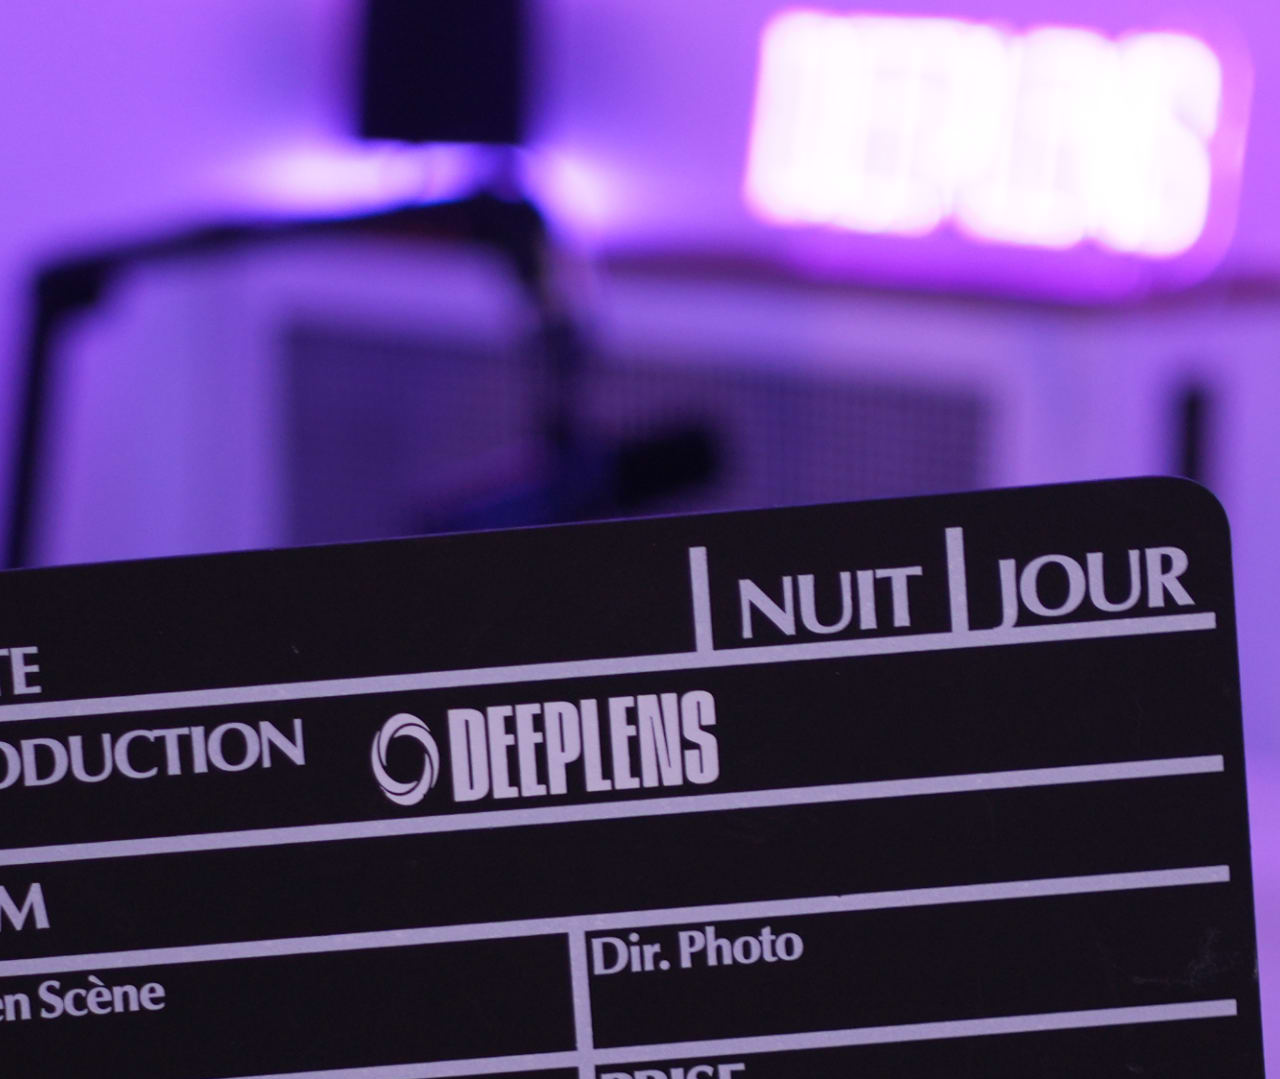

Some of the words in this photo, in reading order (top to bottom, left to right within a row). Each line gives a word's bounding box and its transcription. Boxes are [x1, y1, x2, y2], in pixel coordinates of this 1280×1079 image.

[738, 566, 923, 640] NUIT
[992, 546, 1196, 630] JOUR
[447, 690, 720, 802] DEEPLENS
[591, 932, 671, 976] Dir.
[678, 926, 805, 969] Photo
[38, 975, 166, 1020] Scène
